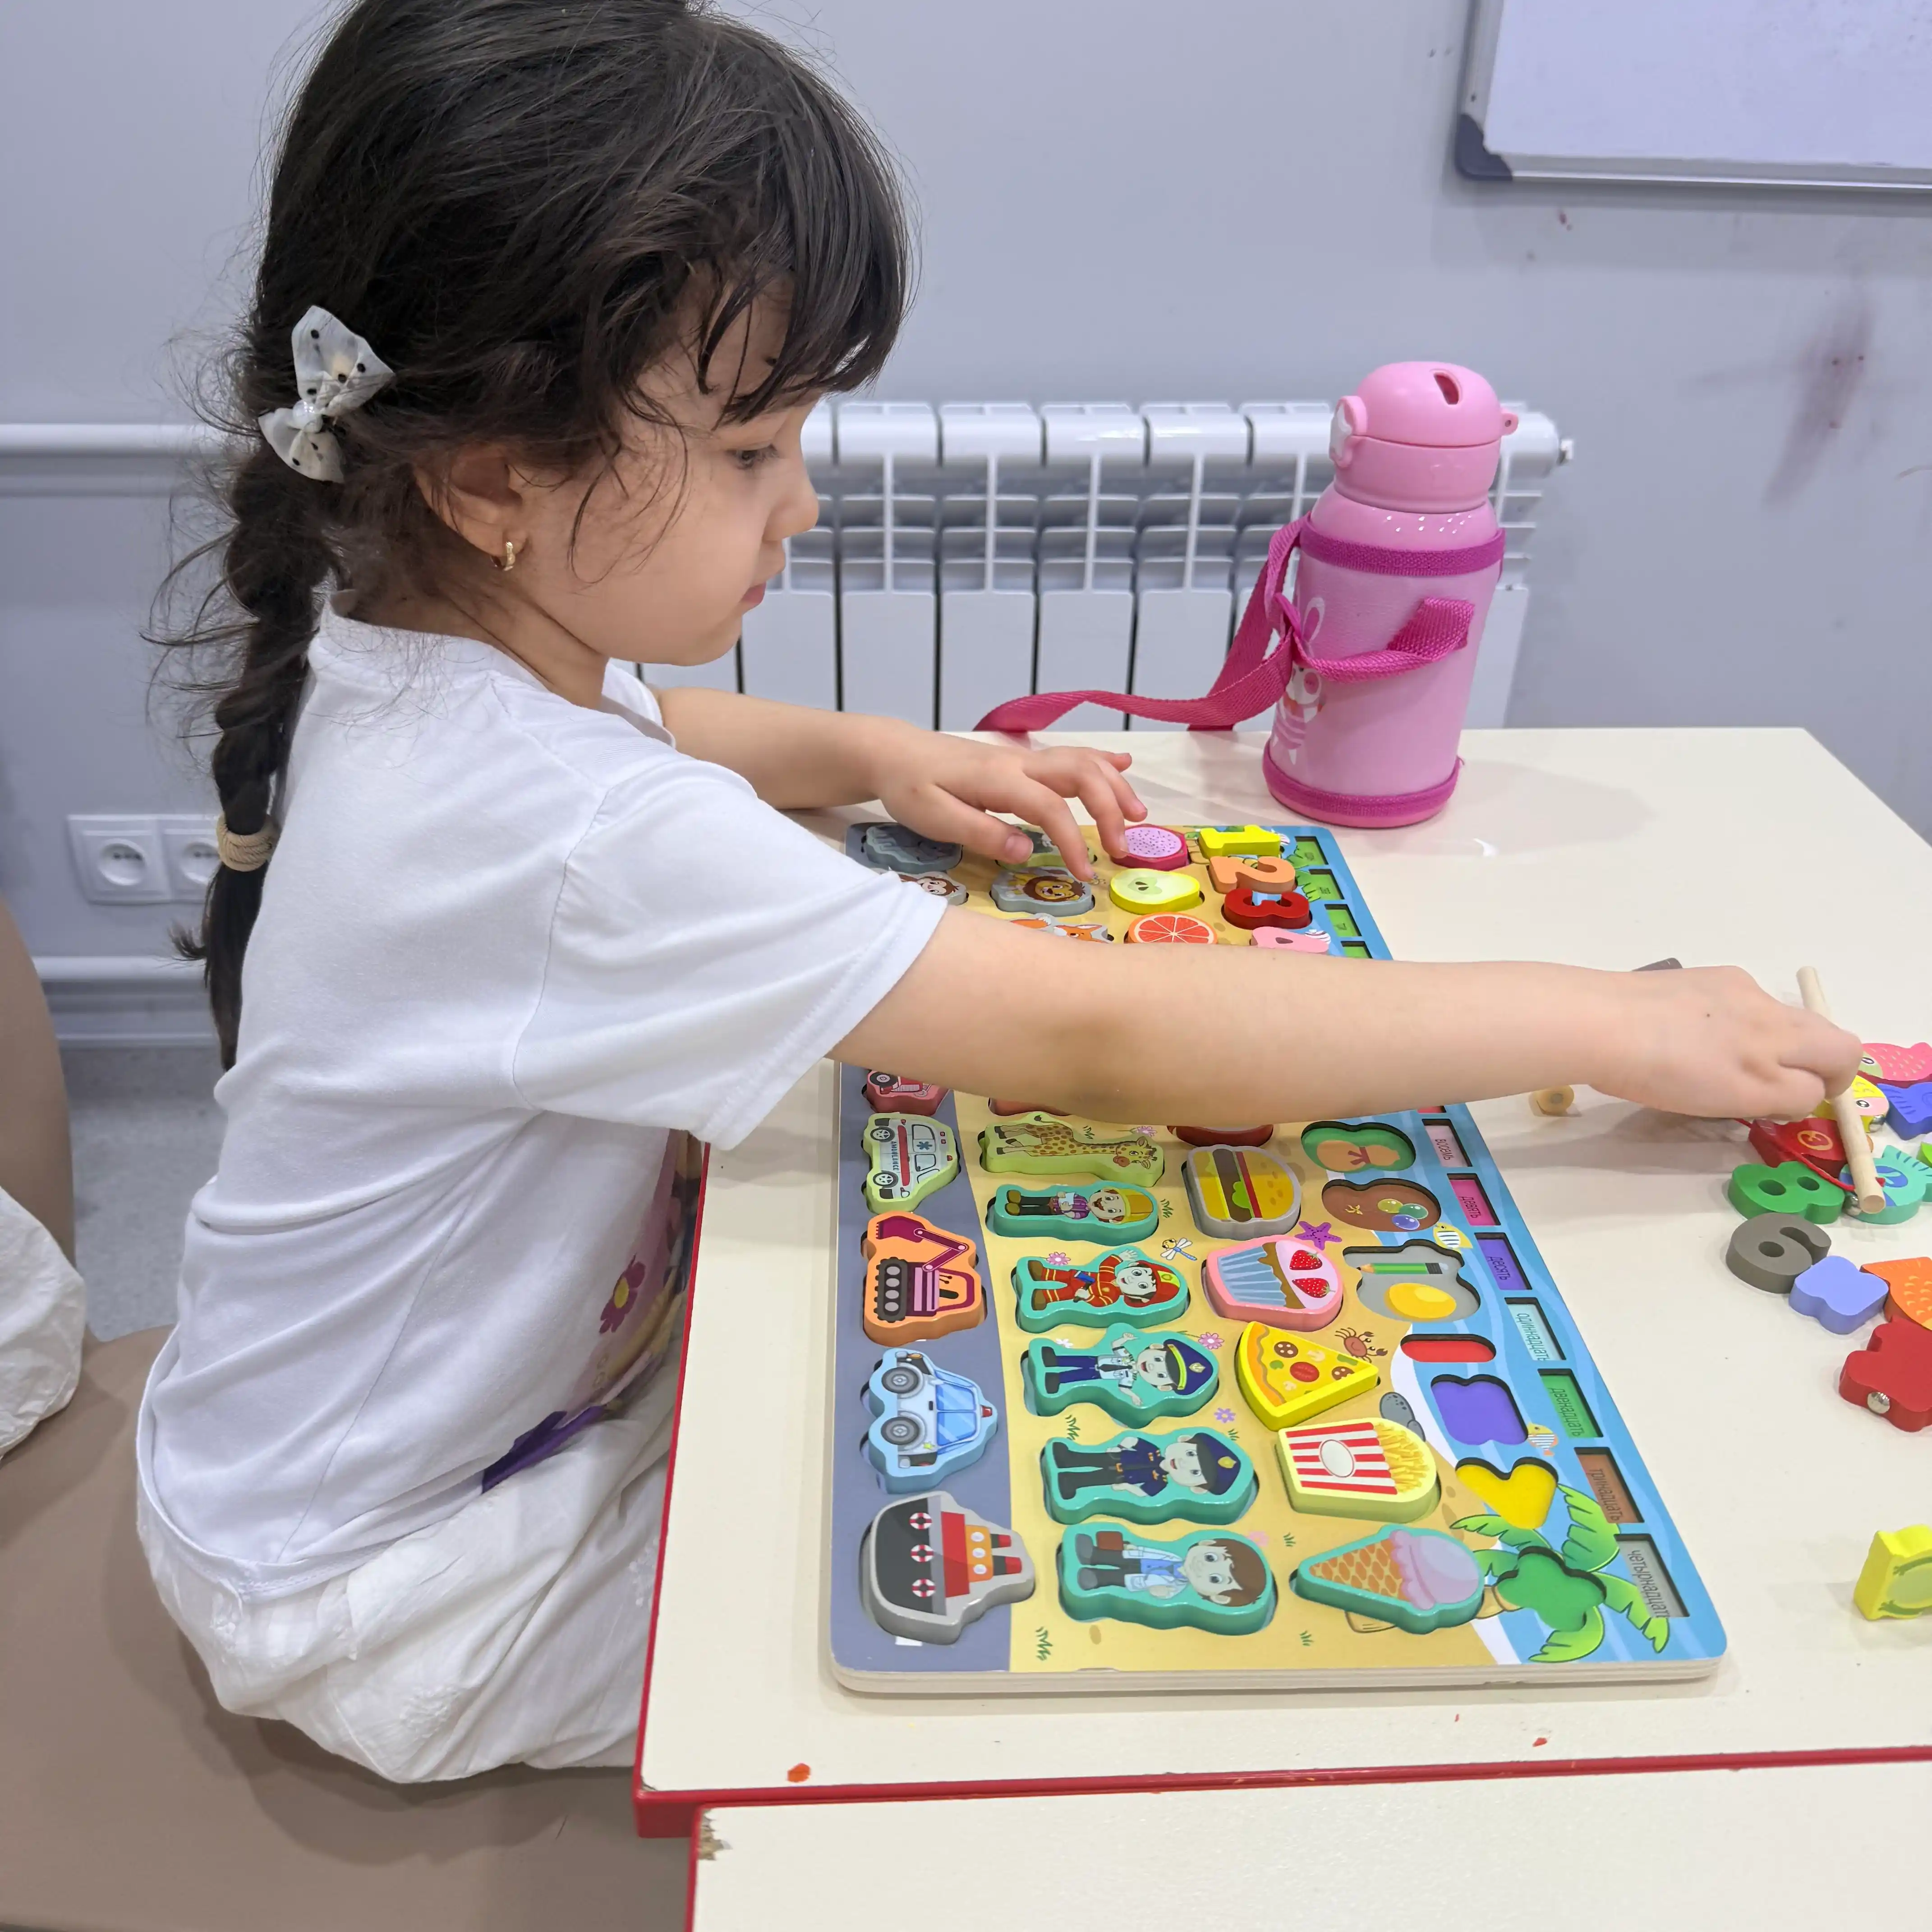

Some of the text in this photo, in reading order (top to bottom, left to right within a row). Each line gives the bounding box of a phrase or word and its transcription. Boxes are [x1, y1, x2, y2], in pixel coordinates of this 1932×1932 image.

[1458, 1196, 1481, 1219] девять
[1486, 1256, 1511, 1280] десять
[1548, 1387, 1585, 1437] двенадцать
[1586, 1468, 1624, 1522] тринадцать
